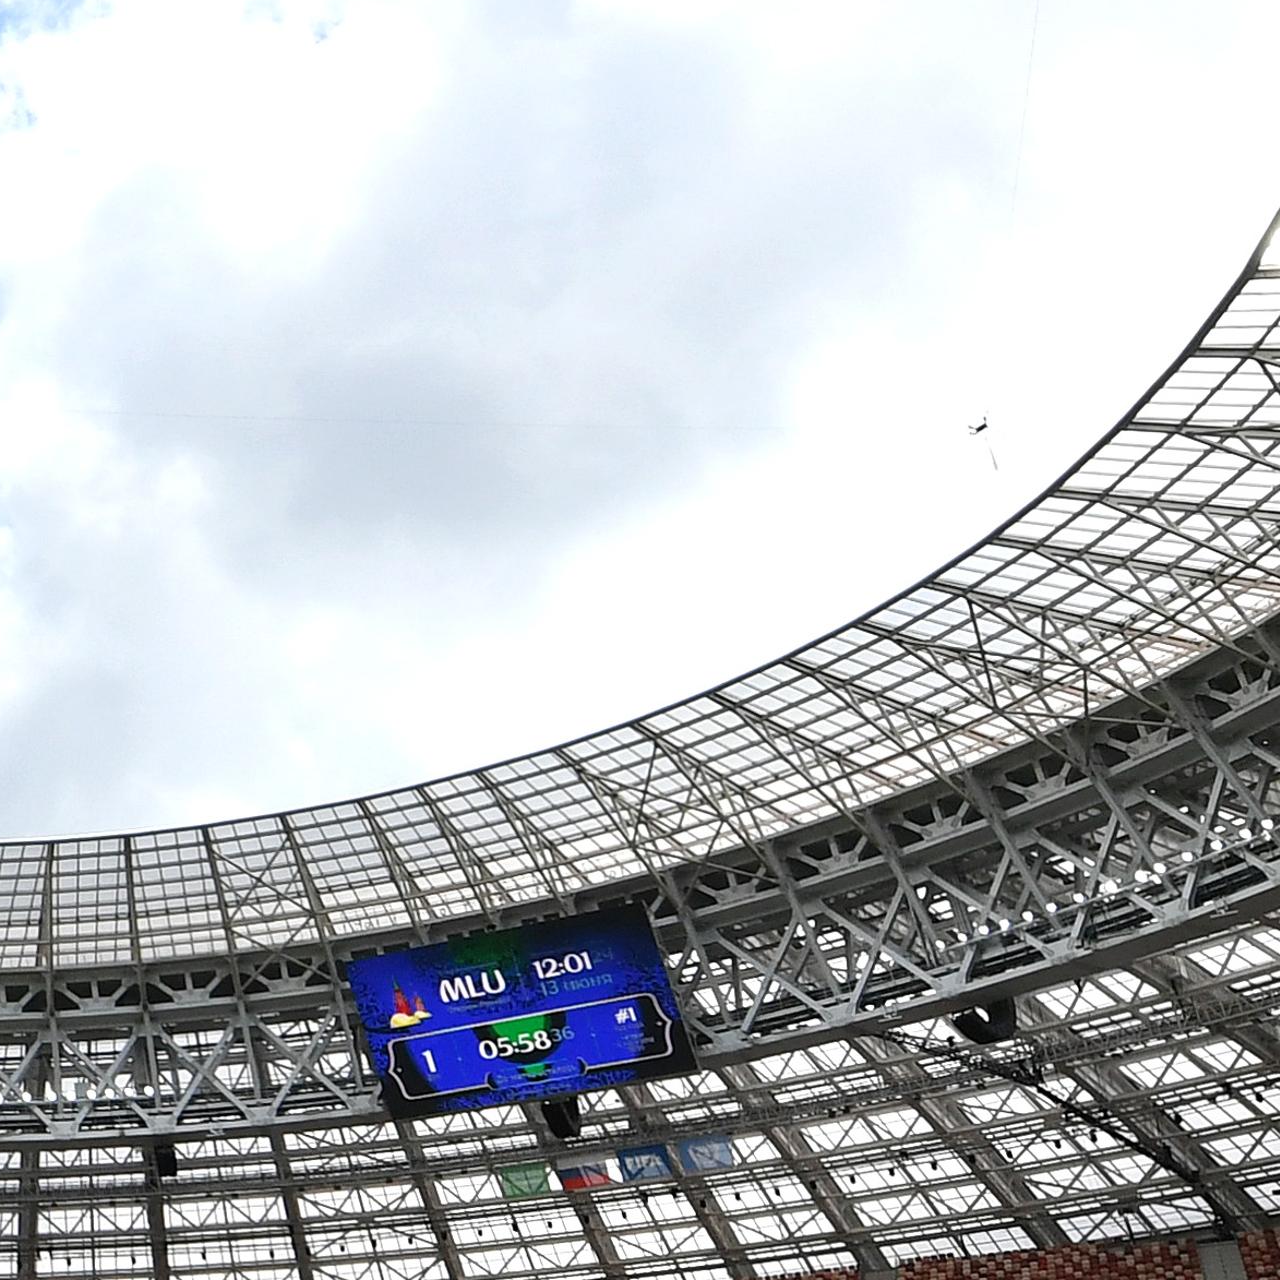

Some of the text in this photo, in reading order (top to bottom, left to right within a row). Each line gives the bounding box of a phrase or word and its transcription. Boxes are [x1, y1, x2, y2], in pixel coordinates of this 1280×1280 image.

[532, 952, 592, 979] 12:01
[439, 969, 506, 1003] MLU
[615, 1007, 637, 1025] #1
[479, 1030, 552, 1059] 05:58
[422, 1050, 437, 1074] 1
